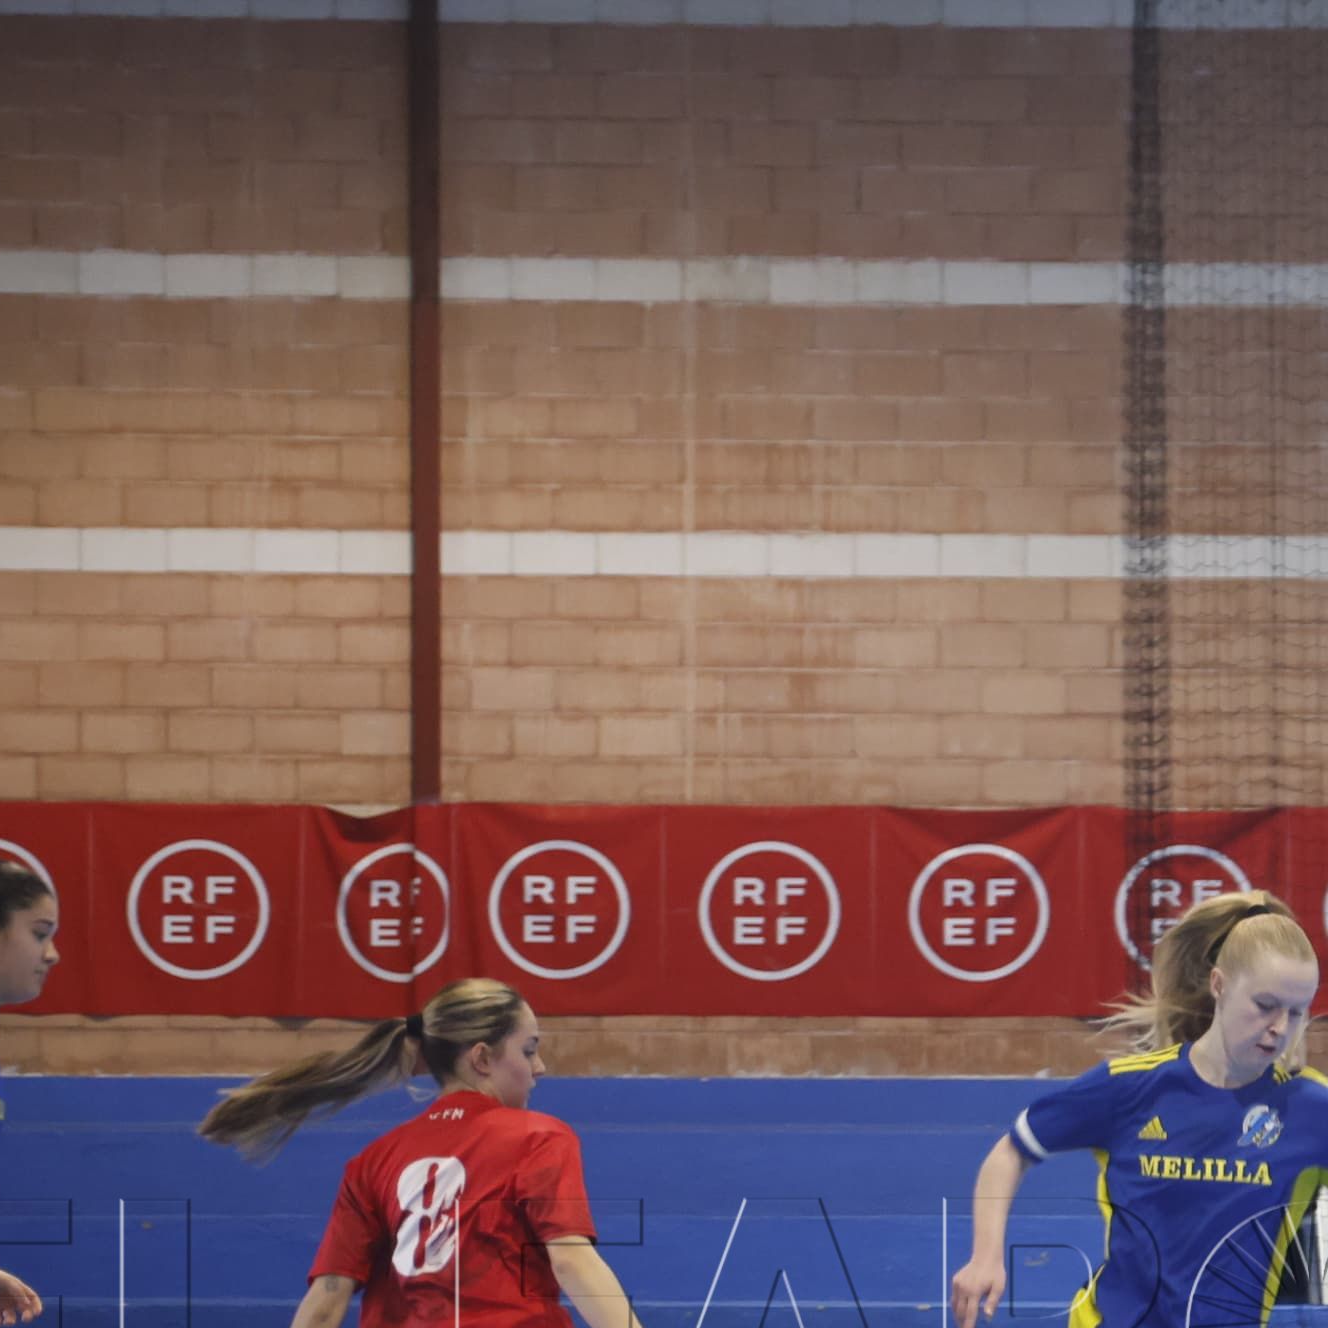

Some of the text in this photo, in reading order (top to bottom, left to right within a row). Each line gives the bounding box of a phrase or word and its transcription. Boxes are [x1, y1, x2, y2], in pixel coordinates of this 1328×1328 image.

[162, 875, 236, 904] RF
[523, 875, 597, 904] RF
[734, 877, 807, 906] RF
[943, 878, 1017, 907] RF
[1151, 878, 1223, 907] RF
[162, 915, 235, 944] EF
[523, 915, 597, 943] EF
[733, 916, 807, 945] EF
[943, 917, 1016, 946] EF
[1139, 1154, 1273, 1186] MELILLA
[391, 1155, 467, 1278] 8
